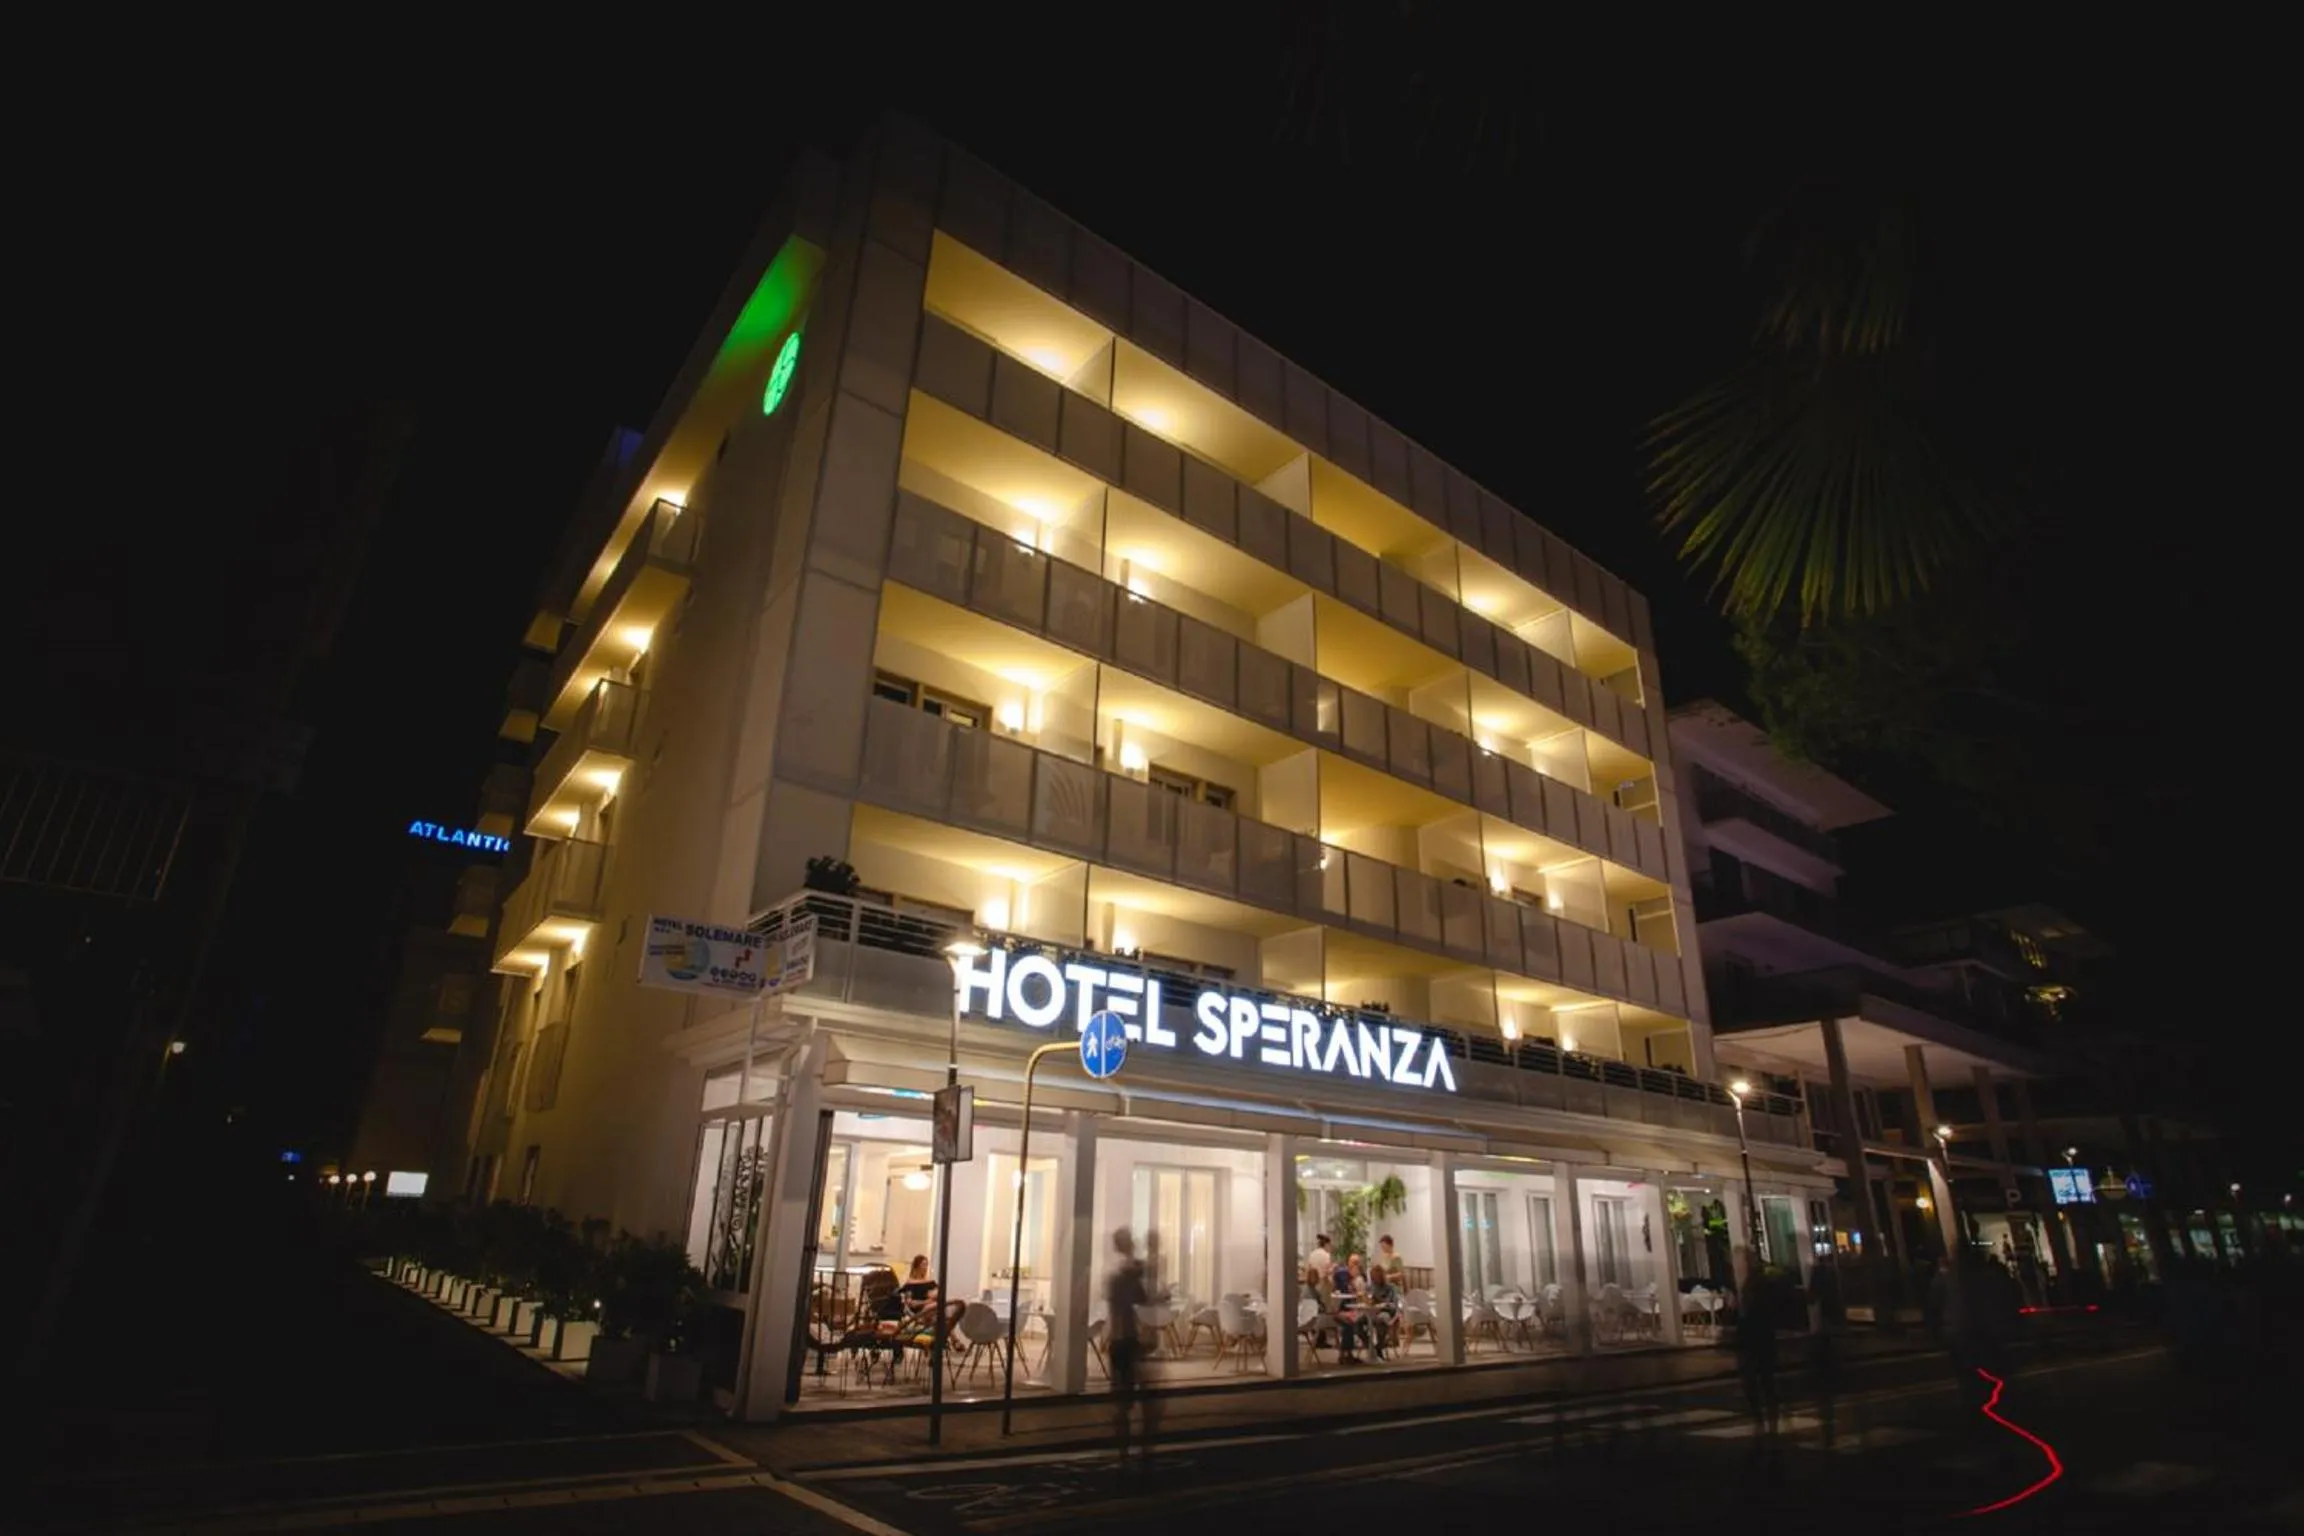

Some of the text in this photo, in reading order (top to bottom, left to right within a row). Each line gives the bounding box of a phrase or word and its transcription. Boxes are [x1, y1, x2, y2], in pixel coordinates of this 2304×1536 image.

[686, 924, 763, 949] SOLEMARE
[958, 947, 1458, 1092] HOTEL SPERANZA
